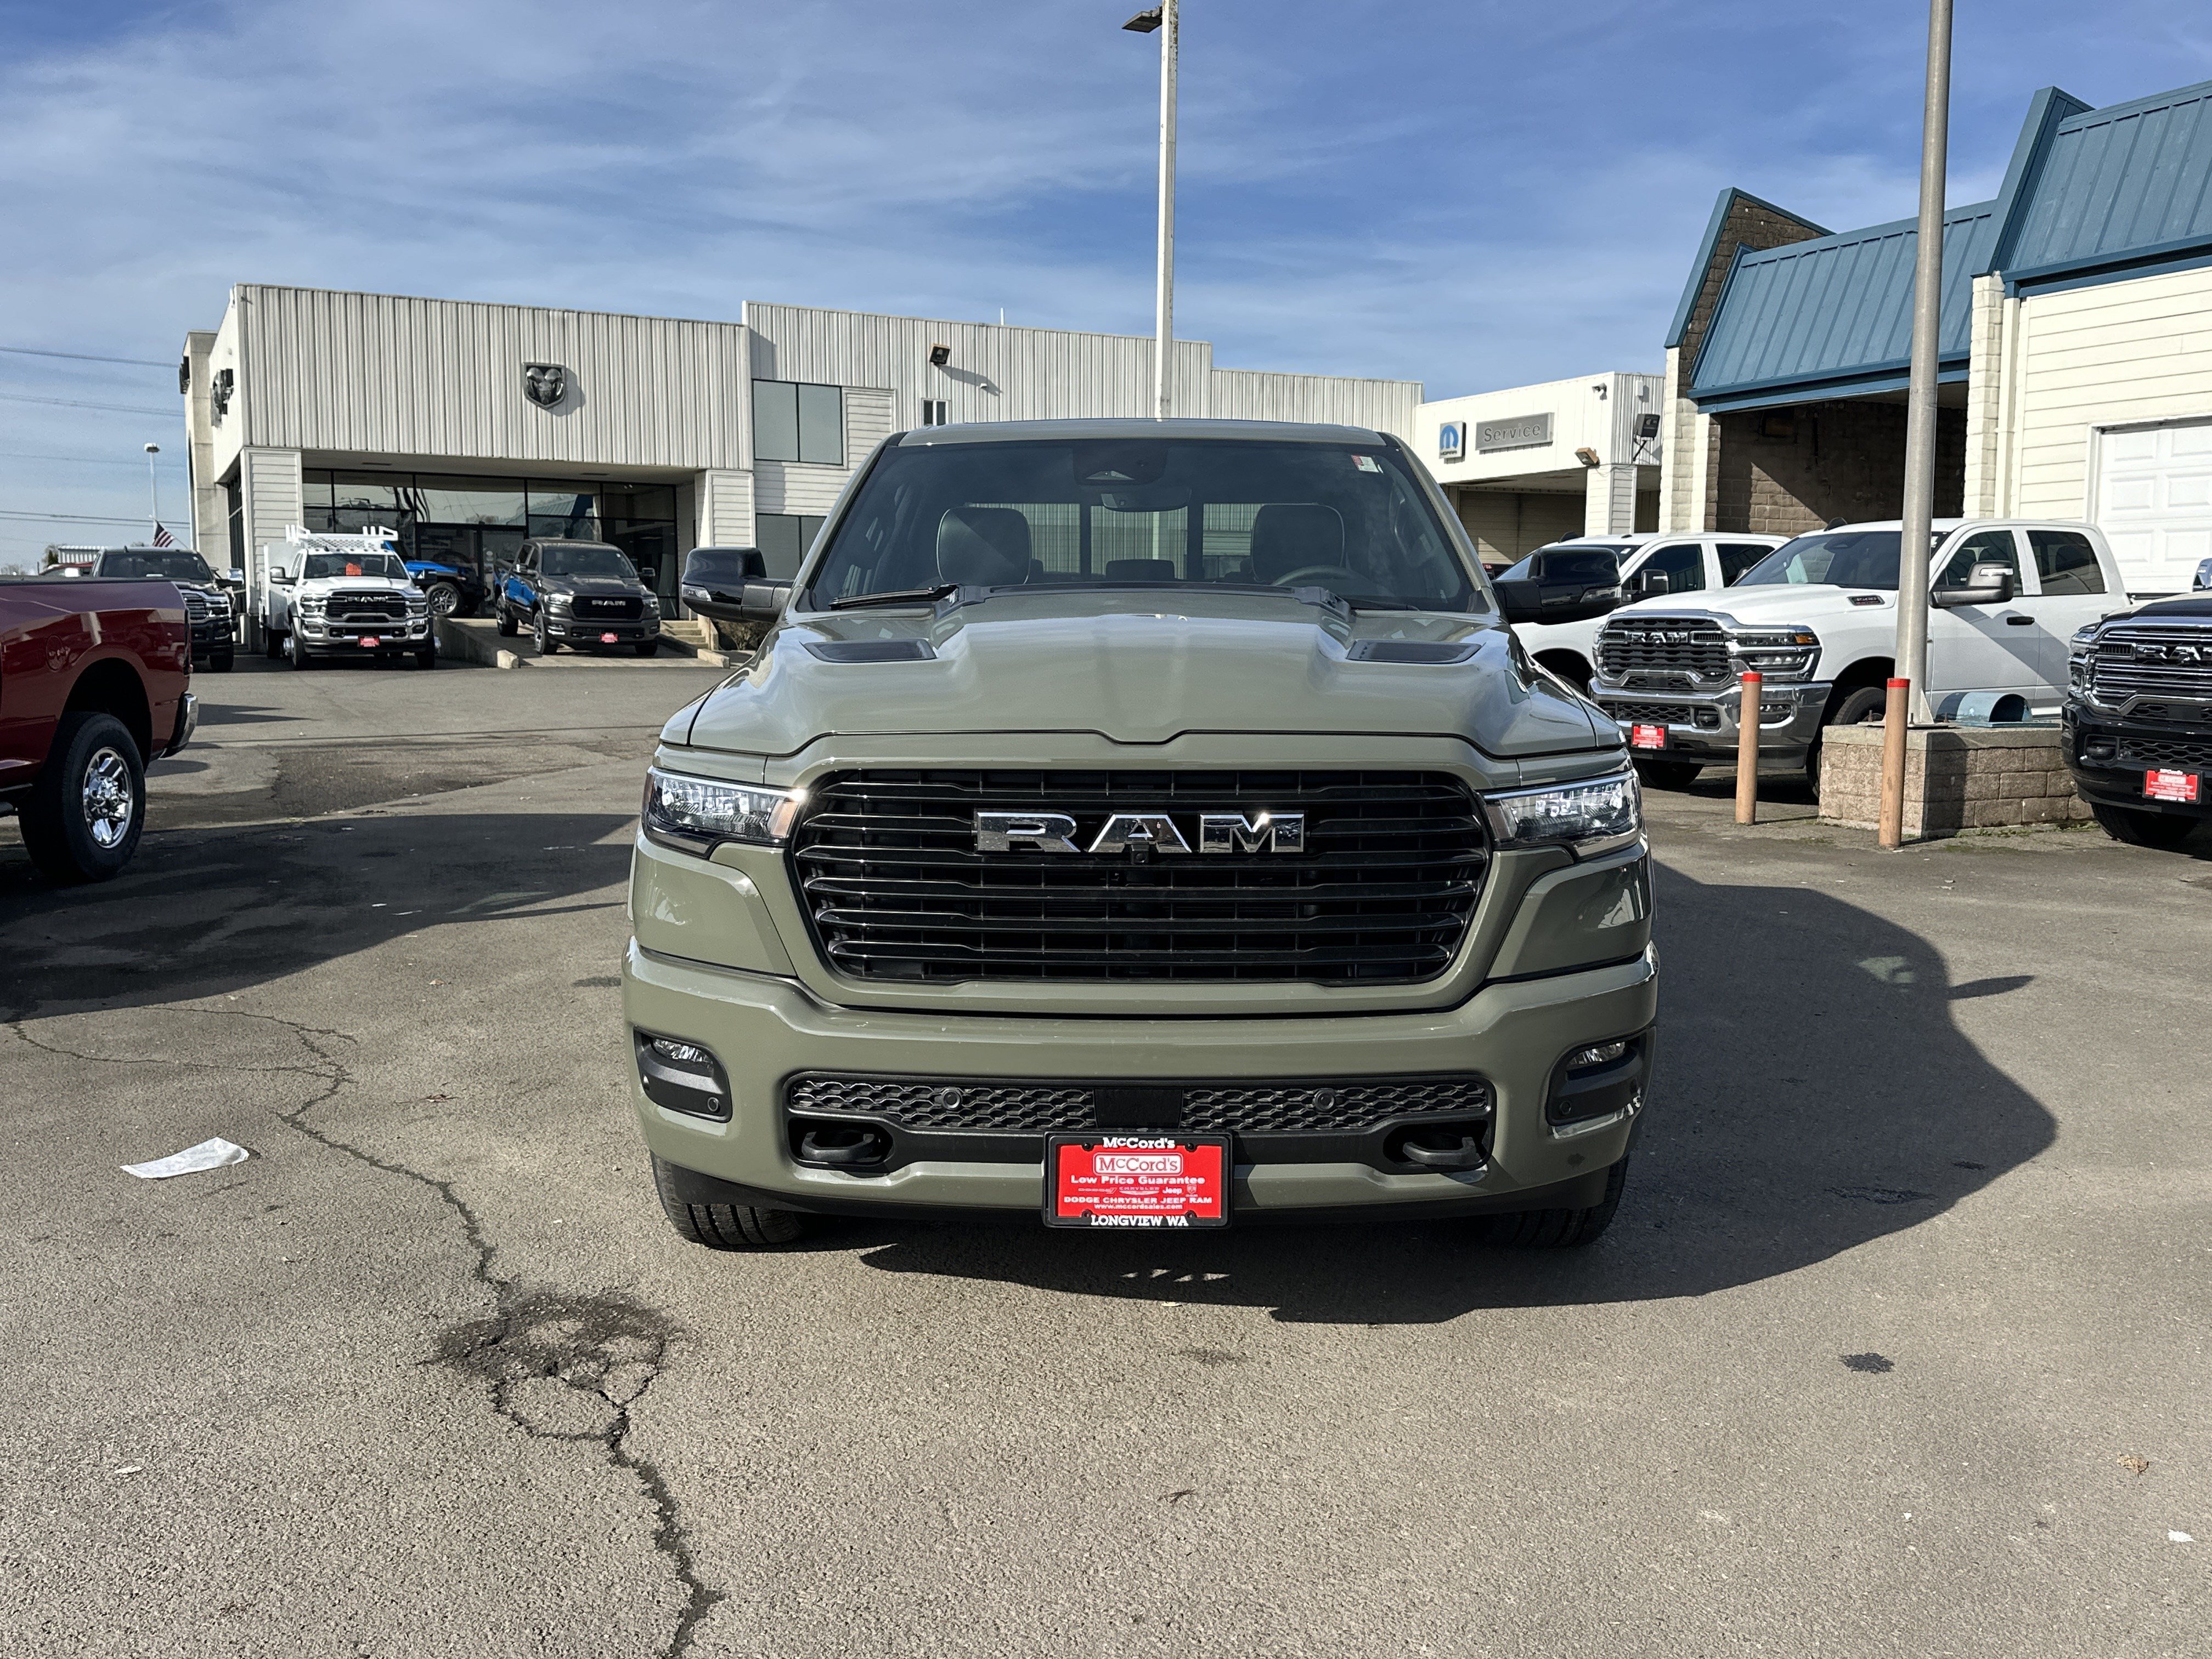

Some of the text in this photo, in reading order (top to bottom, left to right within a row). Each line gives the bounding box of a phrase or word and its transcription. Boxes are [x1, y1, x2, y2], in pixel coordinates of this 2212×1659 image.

[1483, 422, 1541, 442] Service
[1627, 631, 1689, 644] RAM
[976, 810, 1305, 853] RAM
[1103, 1137, 1175, 1149] McCord's
[1099, 1157, 1178, 1171] McCord's
[1071, 1175, 1206, 1184] Low Price Guarantee
[1162, 1186, 1183, 1194] Jeep
[1091, 1215, 1189, 1227] LONGVIEW WA
